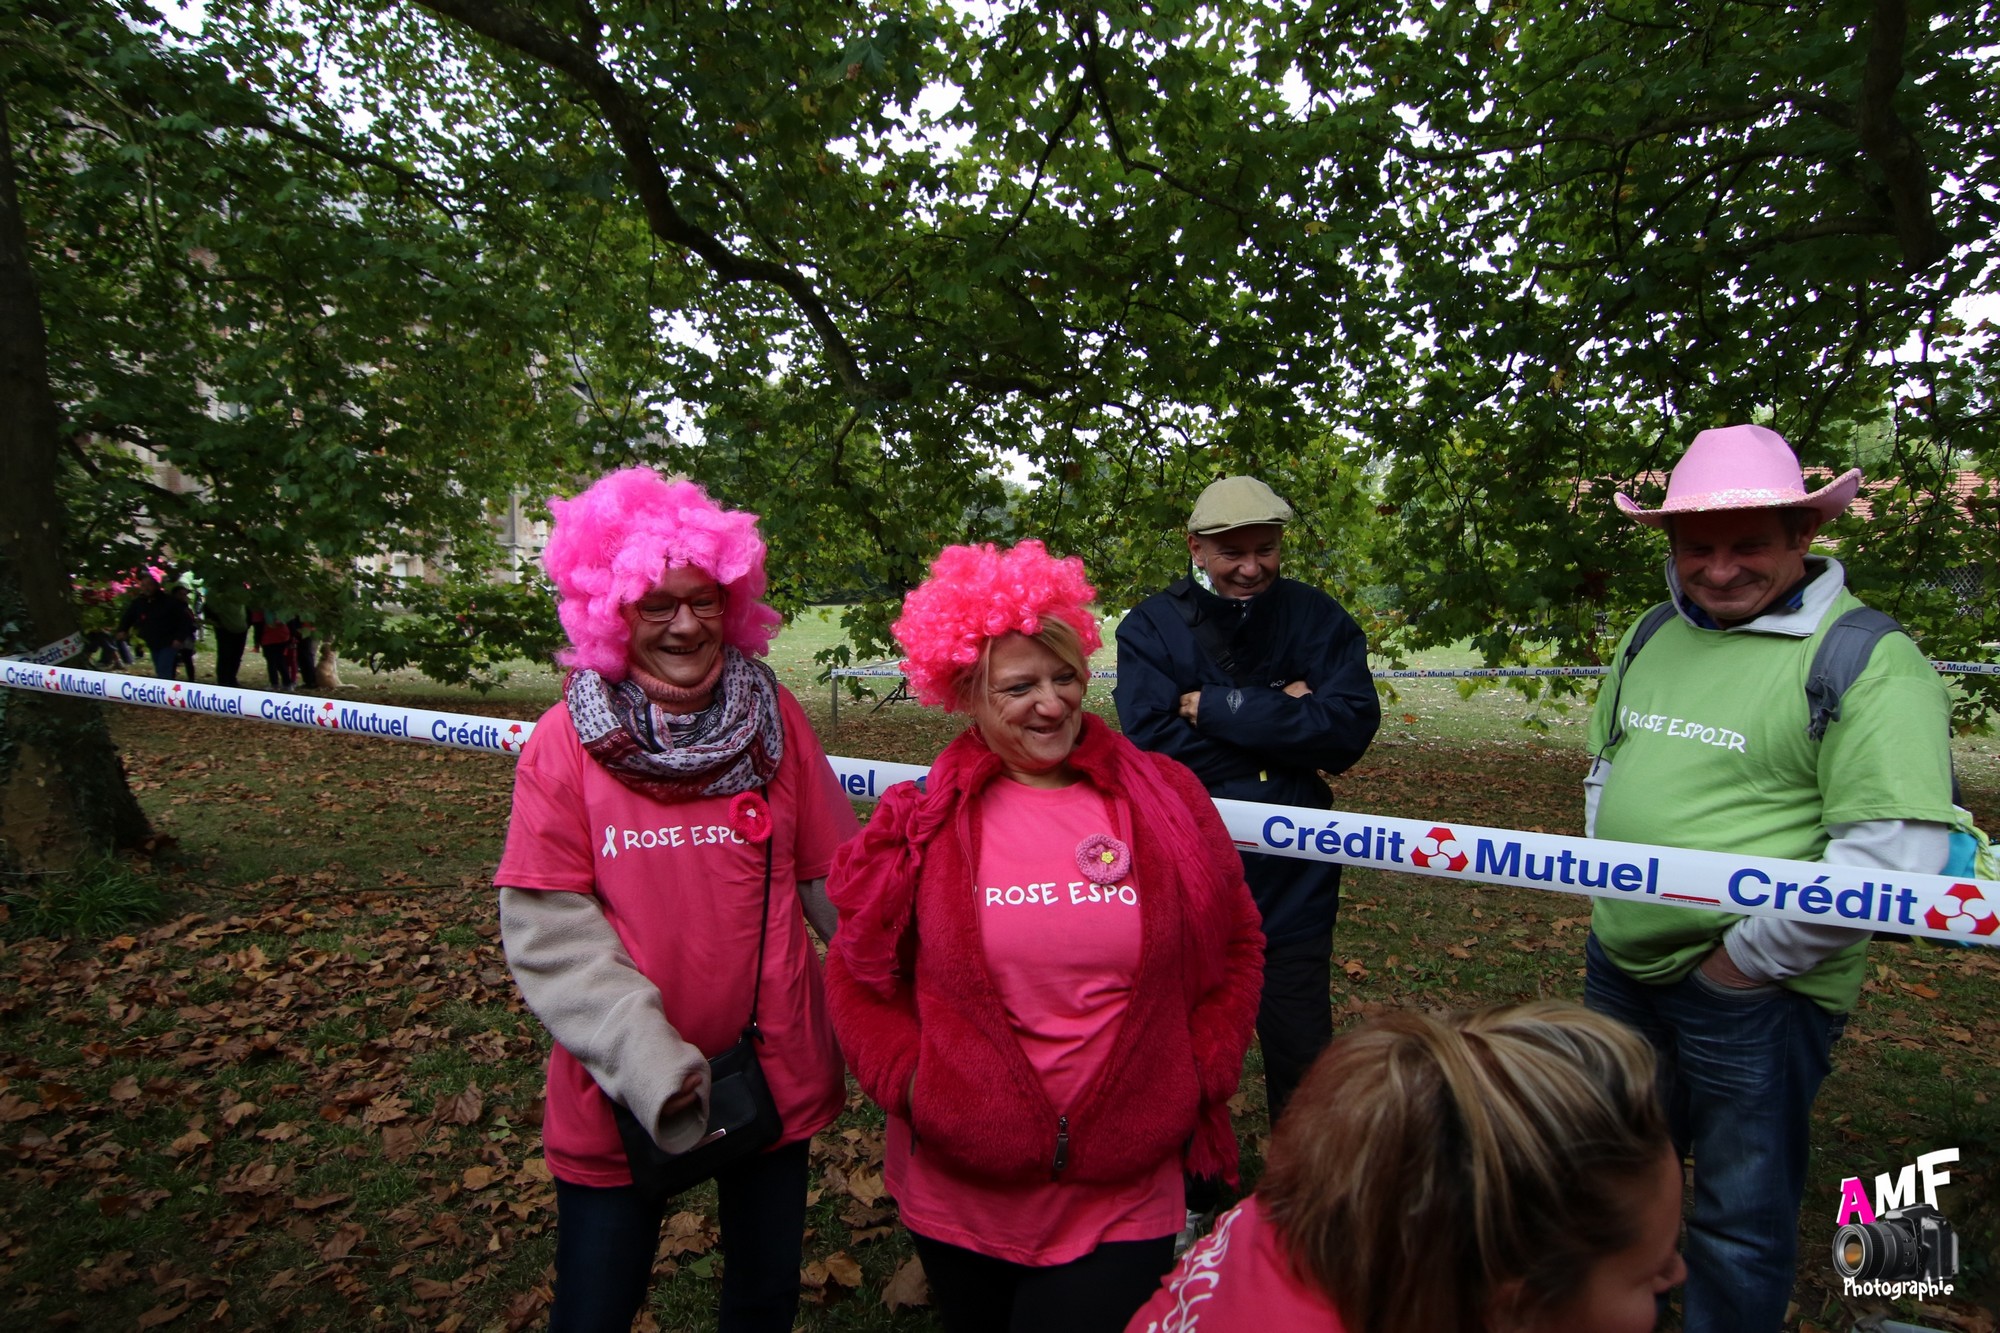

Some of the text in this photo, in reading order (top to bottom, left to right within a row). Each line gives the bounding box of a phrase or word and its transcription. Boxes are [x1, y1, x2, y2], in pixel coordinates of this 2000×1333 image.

[1946, 663, 1982, 673] Mutuel
[6, 666, 499, 749] Crédit Mutuel Crédit Mutuel Crédit Mutuel Crédit
[1667, 718, 1746, 753] ESPOIR
[623, 825, 685, 850] ROSE
[1262, 815, 1918, 925] Crédit Mutuel Crédit
[985, 881, 1141, 907] ROSE ESPO
